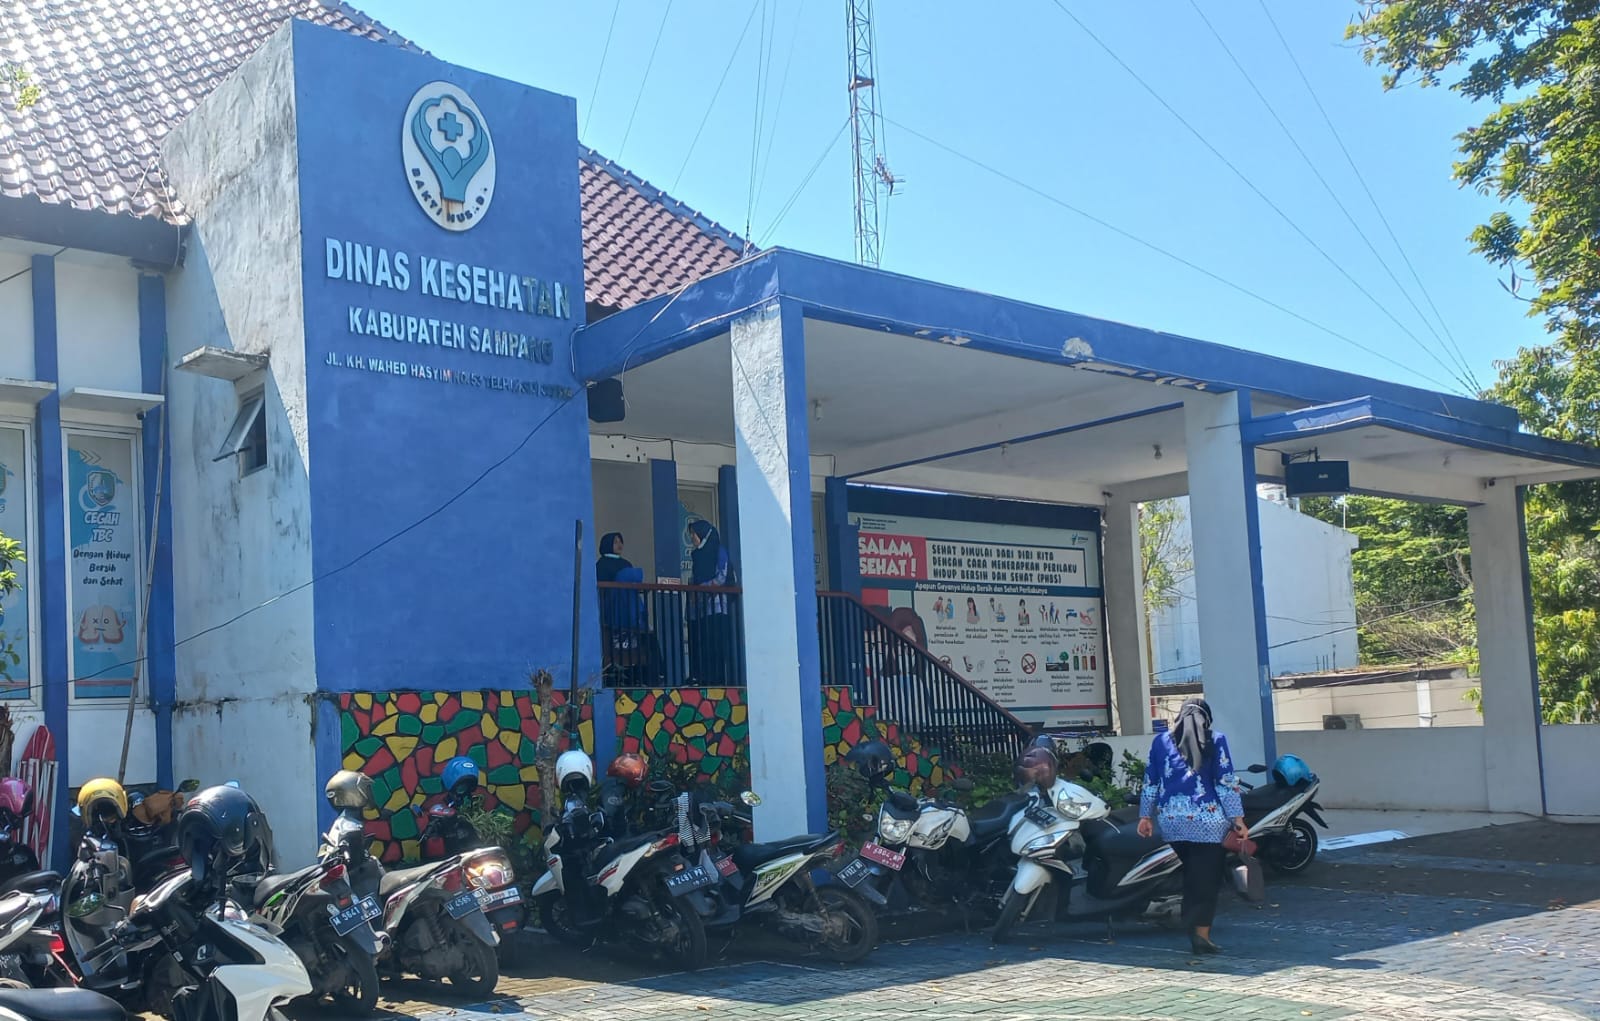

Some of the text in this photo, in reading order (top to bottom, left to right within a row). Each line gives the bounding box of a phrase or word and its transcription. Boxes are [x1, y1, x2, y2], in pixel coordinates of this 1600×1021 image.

[411, 167, 443, 216] BAKTI
[325, 237, 571, 320] DINAS KESEHATAN
[347, 305, 554, 366] KABUPATEN SAMPANG
[325, 351, 342, 366] JL.
[346, 354, 366, 370] KH.
[368, 358, 408, 376] WAHED
[410, 363, 453, 383] HASYIM
[83, 510, 121, 526] CEGAH
[91, 528, 114, 543] TBC
[72, 548, 131, 561] Dengan Hidup
[858, 536, 914, 558] SALAM
[932, 544, 1054, 561] SEHAT DIMULAI DARI DIRI KITA
[88, 562, 117, 573] Bersih
[859, 557, 907, 577] SEHAT
[932, 556, 1077, 574] DENGAN CARA MENERAPKAN PERILAKU
[82, 576, 123, 586] dan Sehat
[933, 568, 957, 579] HIDUP
[961, 569, 988, 580] BERSIH
[991, 571, 1007, 581] DAN
[1010, 572, 1034, 582] SEHAT
